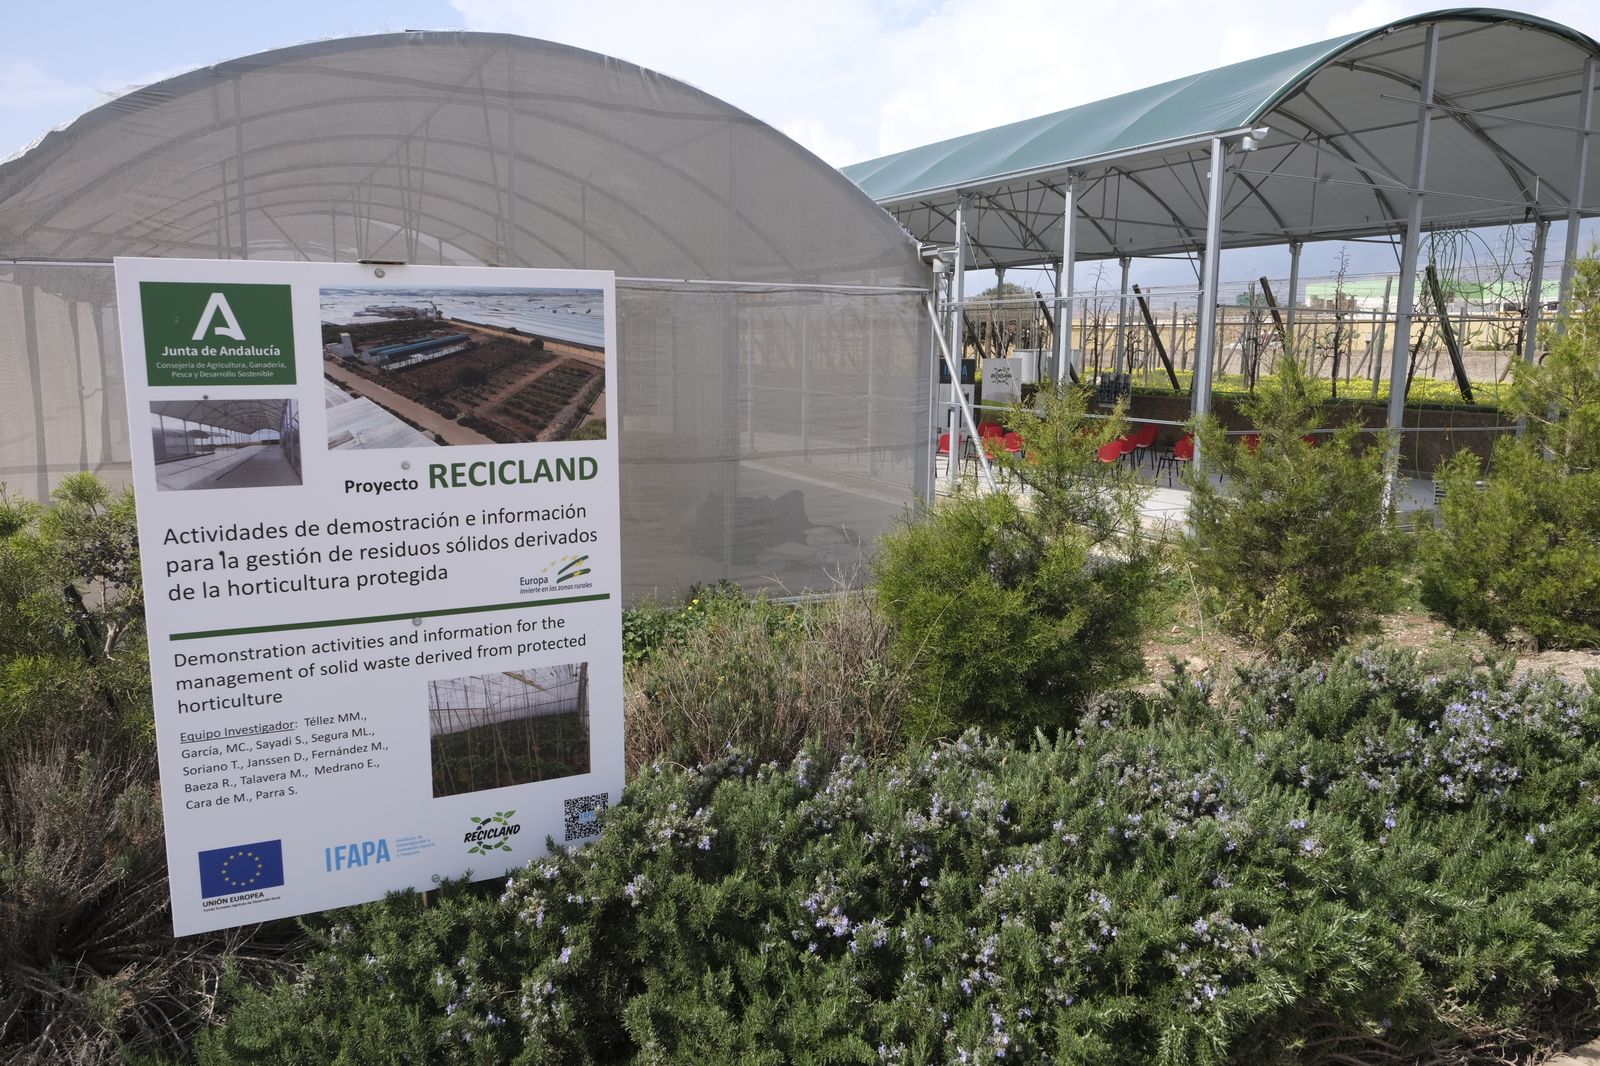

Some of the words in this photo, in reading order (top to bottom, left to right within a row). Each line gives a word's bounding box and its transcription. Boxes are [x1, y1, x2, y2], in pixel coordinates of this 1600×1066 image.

[156, 362, 195, 370] Consejería
[206, 362, 248, 370] Agricultura,
[161, 345, 198, 356] Junta
[201, 345, 217, 356] de
[219, 345, 281, 356] Andalucía
[344, 477, 419, 496] Proyecto
[428, 456, 599, 489] RECICLAND
[163, 522, 288, 545] Actividades
[295, 520, 320, 537] de
[326, 511, 460, 536] demostración
[465, 514, 476, 526] e
[482, 503, 587, 525] información
[166, 557, 214, 577] para
[221, 552, 239, 569] la
[246, 548, 322, 572] gestión
[328, 546, 353, 562] de
[360, 541, 441, 560] residuos
[446, 534, 509, 554] sólidos
[514, 529, 598, 549] derivados
[168, 584, 196, 601] de
[202, 582, 220, 599] la
[227, 574, 350, 597] horticultura
[356, 564, 448, 590] protegida
[520, 577, 548, 586] Europa
[174, 643, 306, 668] Demonstration
[311, 637, 384, 654] activities
[389, 630, 419, 647] and
[423, 623, 512, 643] information
[517, 619, 538, 633] for
[542, 616, 565, 630] the
[176, 666, 293, 691] management
[298, 663, 316, 678] of
[320, 659, 359, 676] solid
[363, 655, 410, 669] waste
[415, 645, 473, 666] derived
[477, 643, 513, 659] from
[517, 633, 586, 656] protected
[177, 692, 283, 715] horticulture
[180, 729, 221, 744] Equipo
[224, 720, 298, 736] Investigador:
[304, 716, 335, 728] Téllez
[337, 711, 367, 722] MM.,
[181, 746, 222, 759] García,
[226, 742, 253, 754] MC.,
[255, 736, 292, 751] Sayadi
[295, 735, 308, 745] S.,
[311, 731, 349, 743] Segura
[351, 727, 375, 737] ML.,
[182, 763, 228, 776] Soriano
[231, 760, 244, 770] T.,
[247, 754, 291, 768] Janssen
[294, 752, 309, 762] D.,
[311, 744, 368, 759] Fernández
[371, 741, 389, 751] M.,
[184, 780, 219, 793] Baeza
[222, 778, 237, 788] R.,
[240, 771, 287, 785] Talavera
[290, 769, 309, 779] M.,
[314, 761, 364, 776] Medrano
[367, 759, 380, 768] E.,
[186, 797, 212, 810] Cara
[215, 795, 231, 806] de
[233, 792, 253, 803] M.,
[256, 788, 285, 800] Parra
[288, 786, 298, 795] S.
[463, 824, 521, 843] RECICLAND
[325, 838, 391, 872] IFAPA
[202, 897, 229, 908] UNIÓN
[229, 891, 265, 903] EUROPEA
